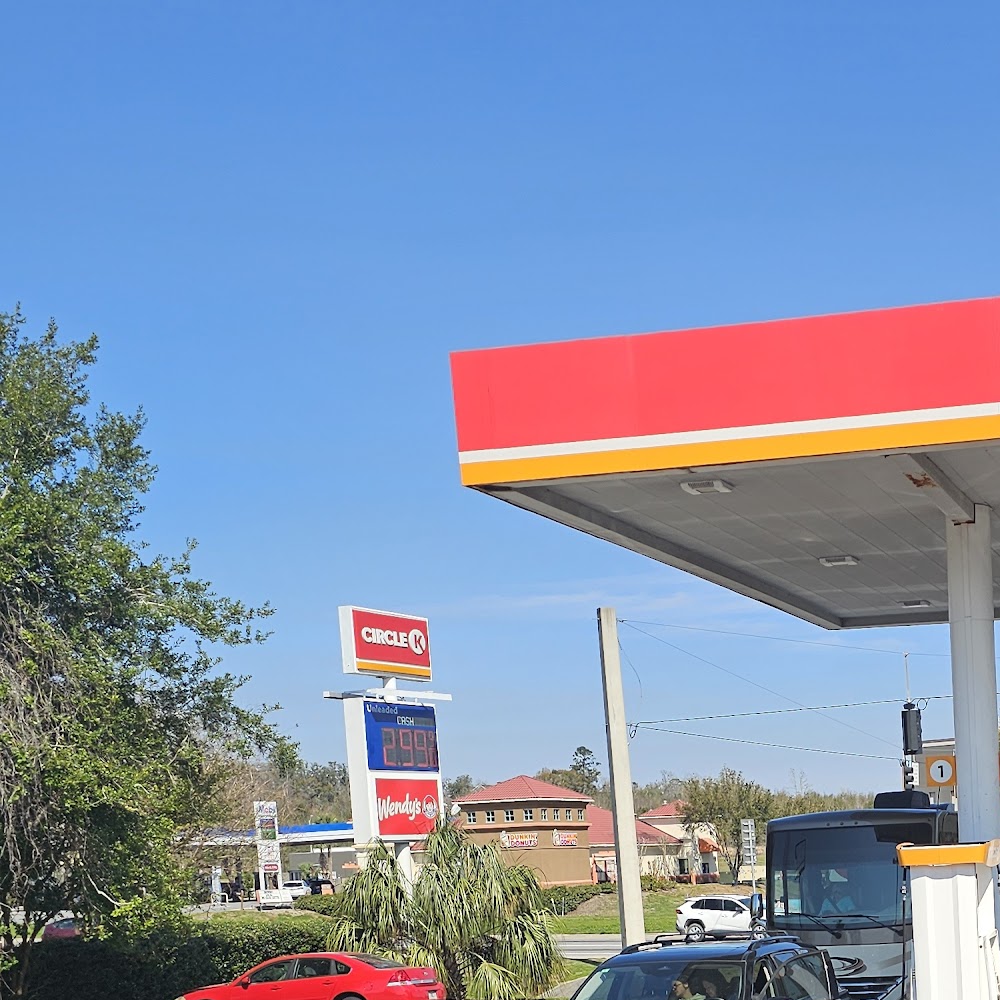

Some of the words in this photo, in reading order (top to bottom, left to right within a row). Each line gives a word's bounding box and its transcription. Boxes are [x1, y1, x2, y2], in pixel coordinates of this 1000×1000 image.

[361, 626, 408, 648] CIRCLE
[408, 629, 426, 655] K
[366, 703, 398, 715] Unleaded
[397, 716, 415, 726] CASH
[937, 765, 944, 778] 1
[378, 792, 421, 821] Wendy's
